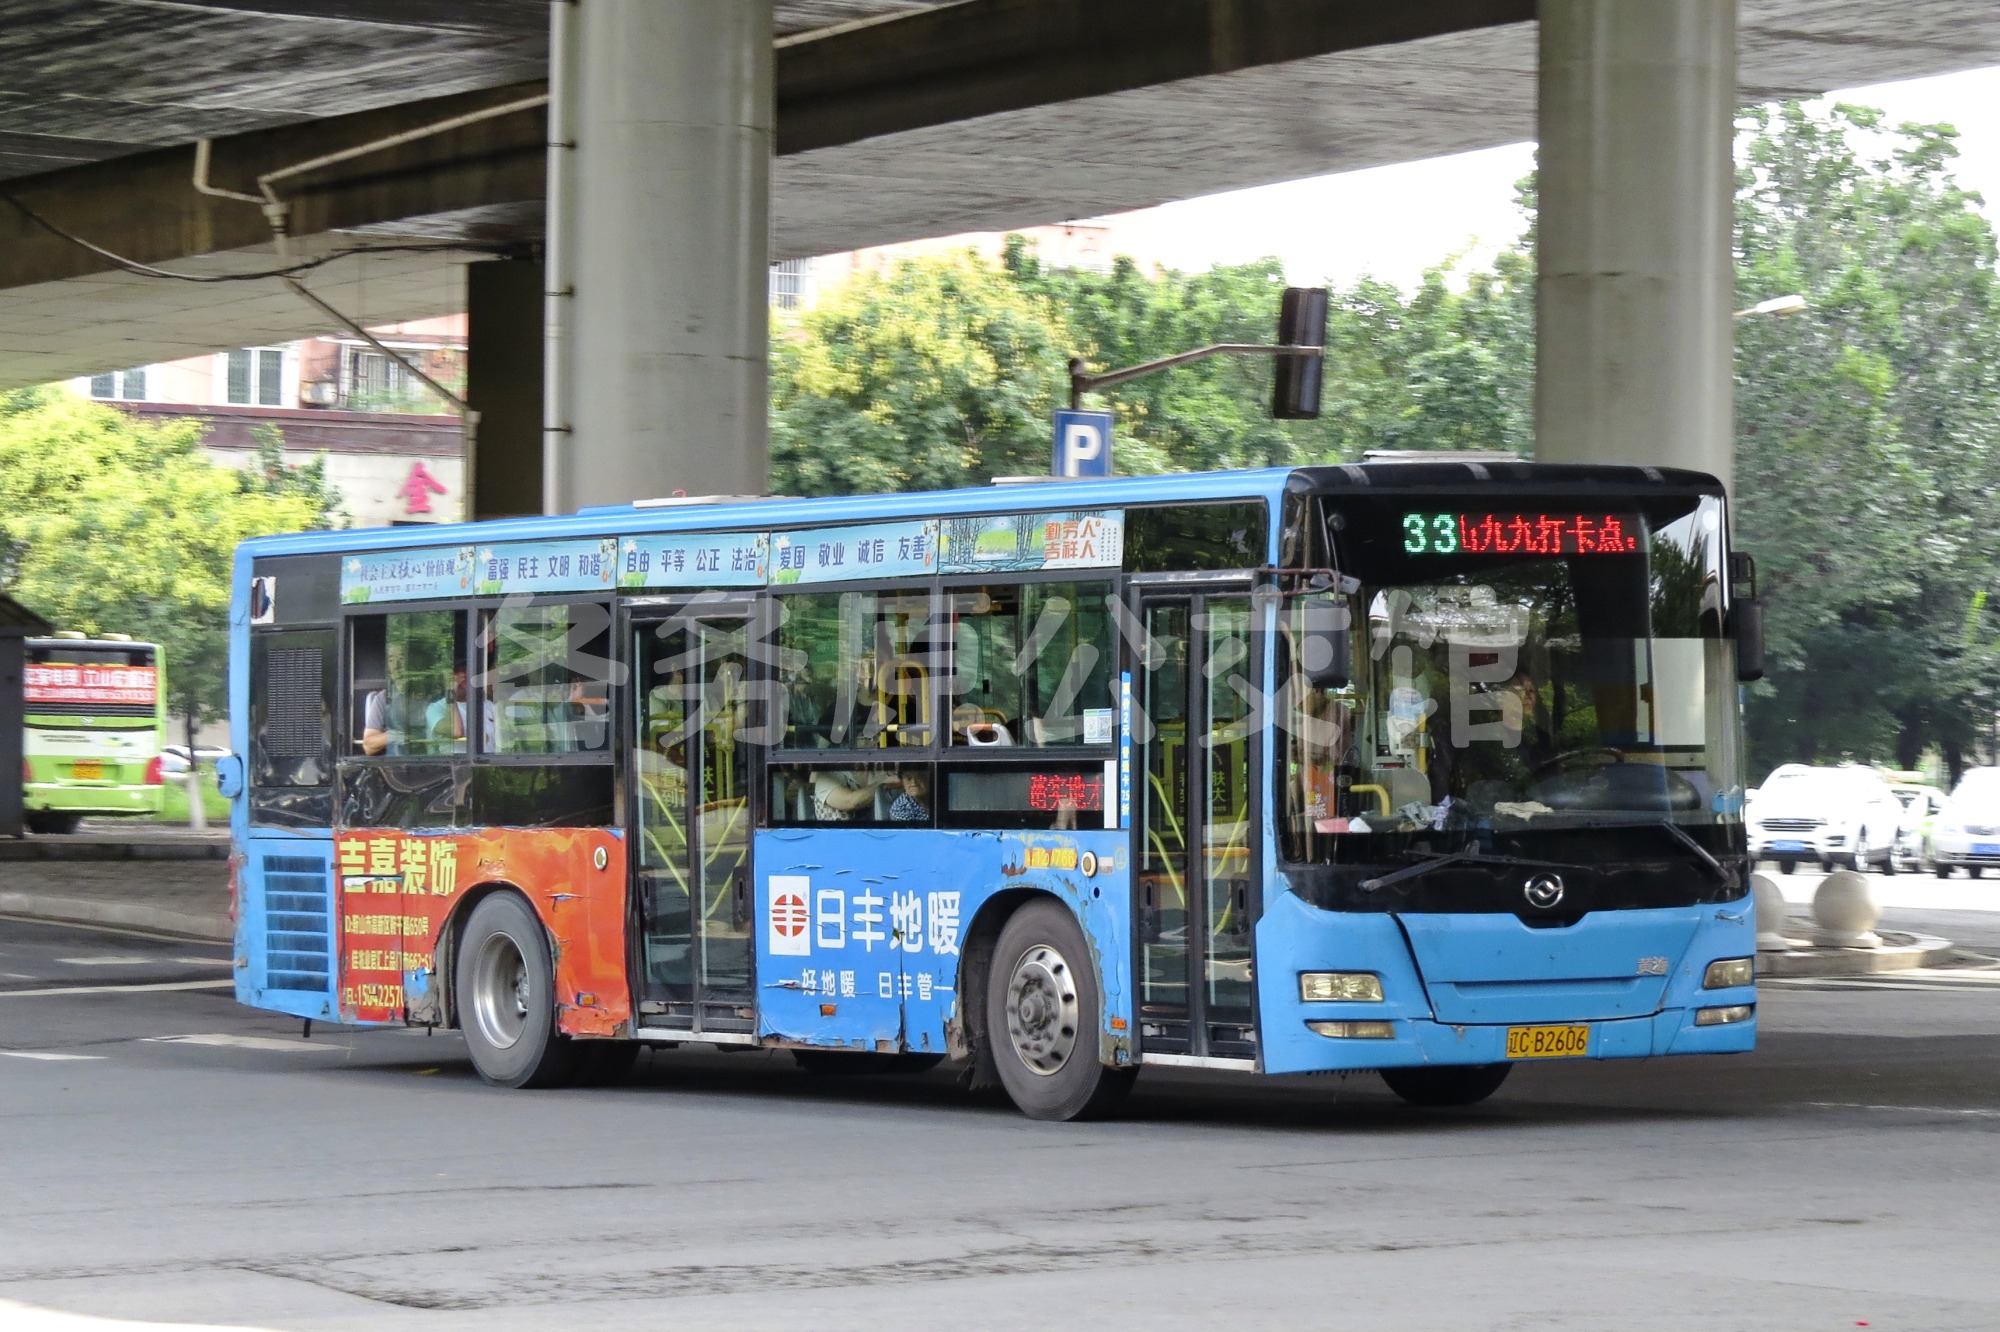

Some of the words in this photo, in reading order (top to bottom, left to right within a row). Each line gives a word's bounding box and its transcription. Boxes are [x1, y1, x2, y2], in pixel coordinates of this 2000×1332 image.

[1064, 424, 1102, 477] P
[1045, 520, 1096, 540] 勤劳人
[1403, 514, 1457, 553] 33
[626, 550, 650, 573] 自由
[661, 549, 685, 572] 平等
[695, 548, 719, 571] 公正
[731, 547, 757, 571] 法治
[780, 545, 806, 570] 爱国
[818, 542, 845, 567] 敬业
[857, 540, 884, 564] 诚信
[898, 536, 925, 561] 友善
[1044, 540, 1096, 560] 吉祥人
[360, 558, 456, 582] 社会主义核心价值观
[487, 558, 509, 582] 富强
[517, 556, 540, 580] 民主
[548, 555, 570, 578] 文明
[578, 553, 601, 577] 和谐
[339, 837, 458, 896] 吉嘉装饰
[816, 887, 961, 956] 日丰地暖
